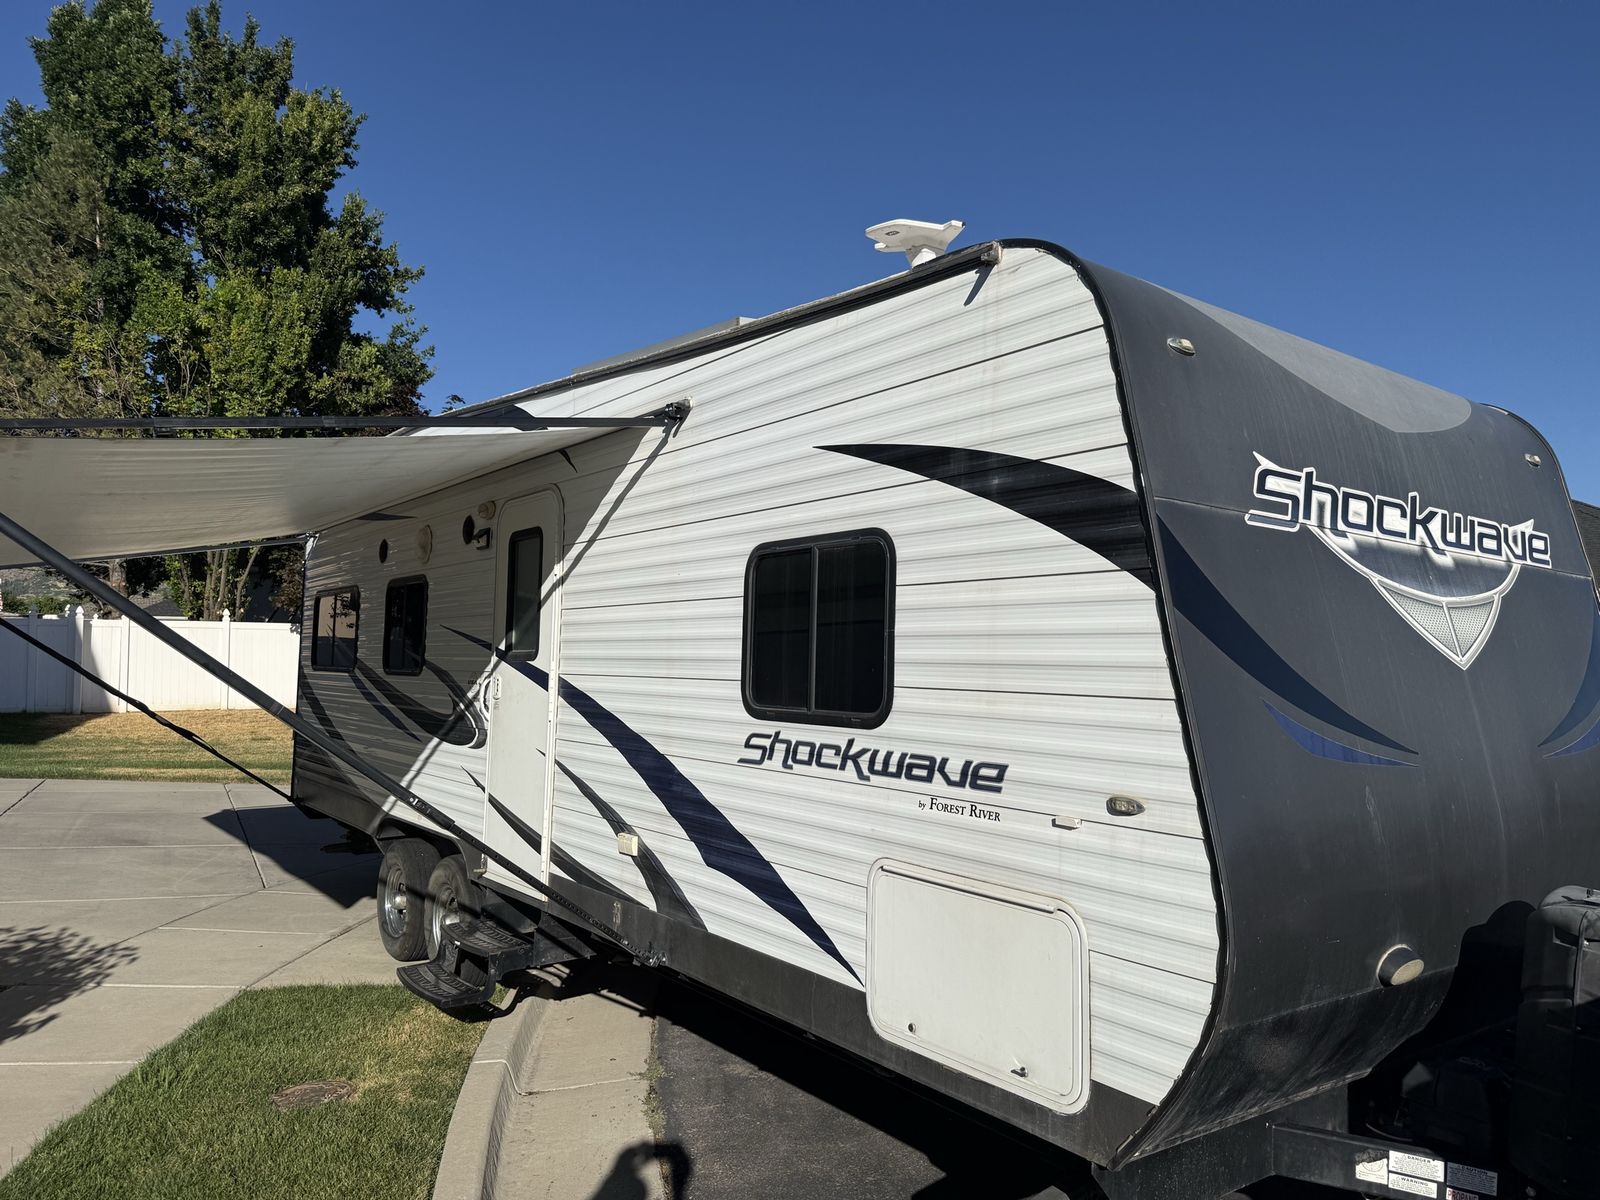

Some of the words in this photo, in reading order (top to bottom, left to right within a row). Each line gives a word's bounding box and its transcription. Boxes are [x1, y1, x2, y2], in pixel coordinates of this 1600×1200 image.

[1245, 466, 1552, 568] Shockwave
[737, 730, 1009, 793] Shockwave
[918, 800, 927, 811] by
[929, 798, 967, 816] FOREST
[969, 804, 1001, 822] RIVER
[1407, 1155, 1432, 1164] DANGER
[1461, 1165, 1489, 1176] CAUTION
[1401, 1176, 1429, 1187] WARNING
